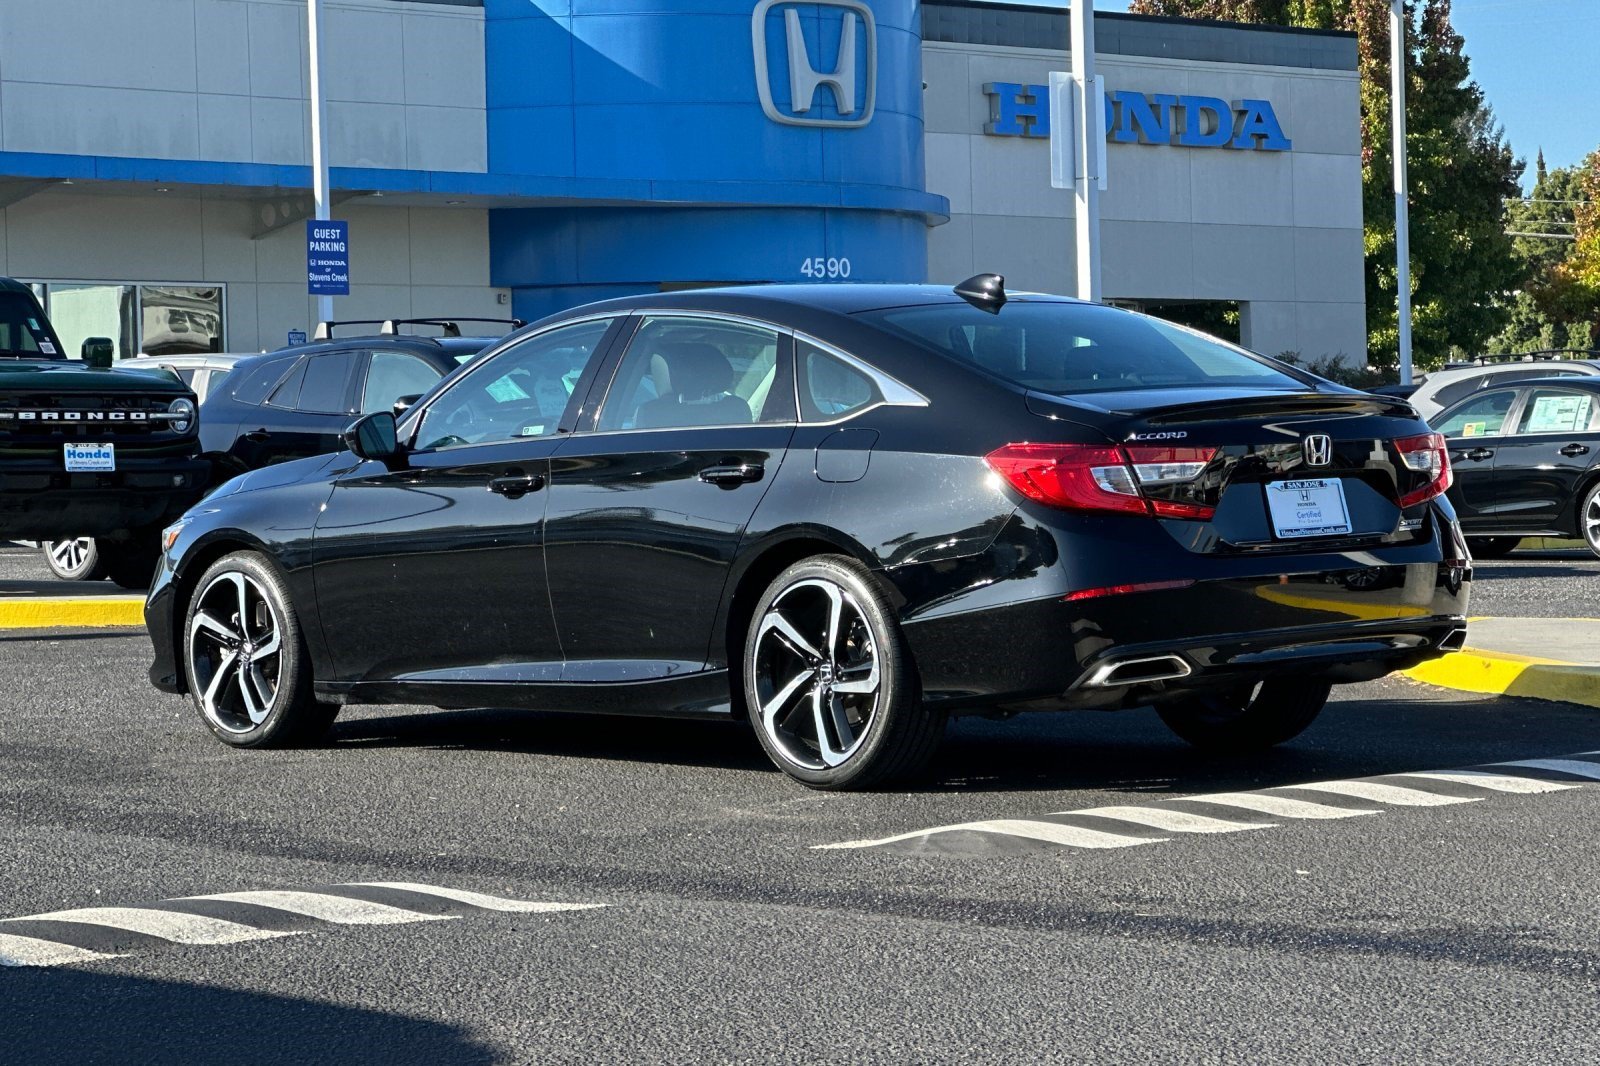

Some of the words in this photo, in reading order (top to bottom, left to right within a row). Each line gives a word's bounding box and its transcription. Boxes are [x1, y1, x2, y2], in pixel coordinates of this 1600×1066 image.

[983, 82, 1292, 151] HNDA
[314, 228, 340, 239] GUEST
[309, 241, 345, 252] PARKING
[800, 257, 851, 278] 4590
[309, 272, 331, 281] Stevens
[331, 273, 348, 282] Creek
[18, 412, 146, 420] BRONCO
[1123, 431, 1188, 442] ACCORD
[67, 449, 111, 458] Honda
[1296, 510, 1322, 519] Certified
